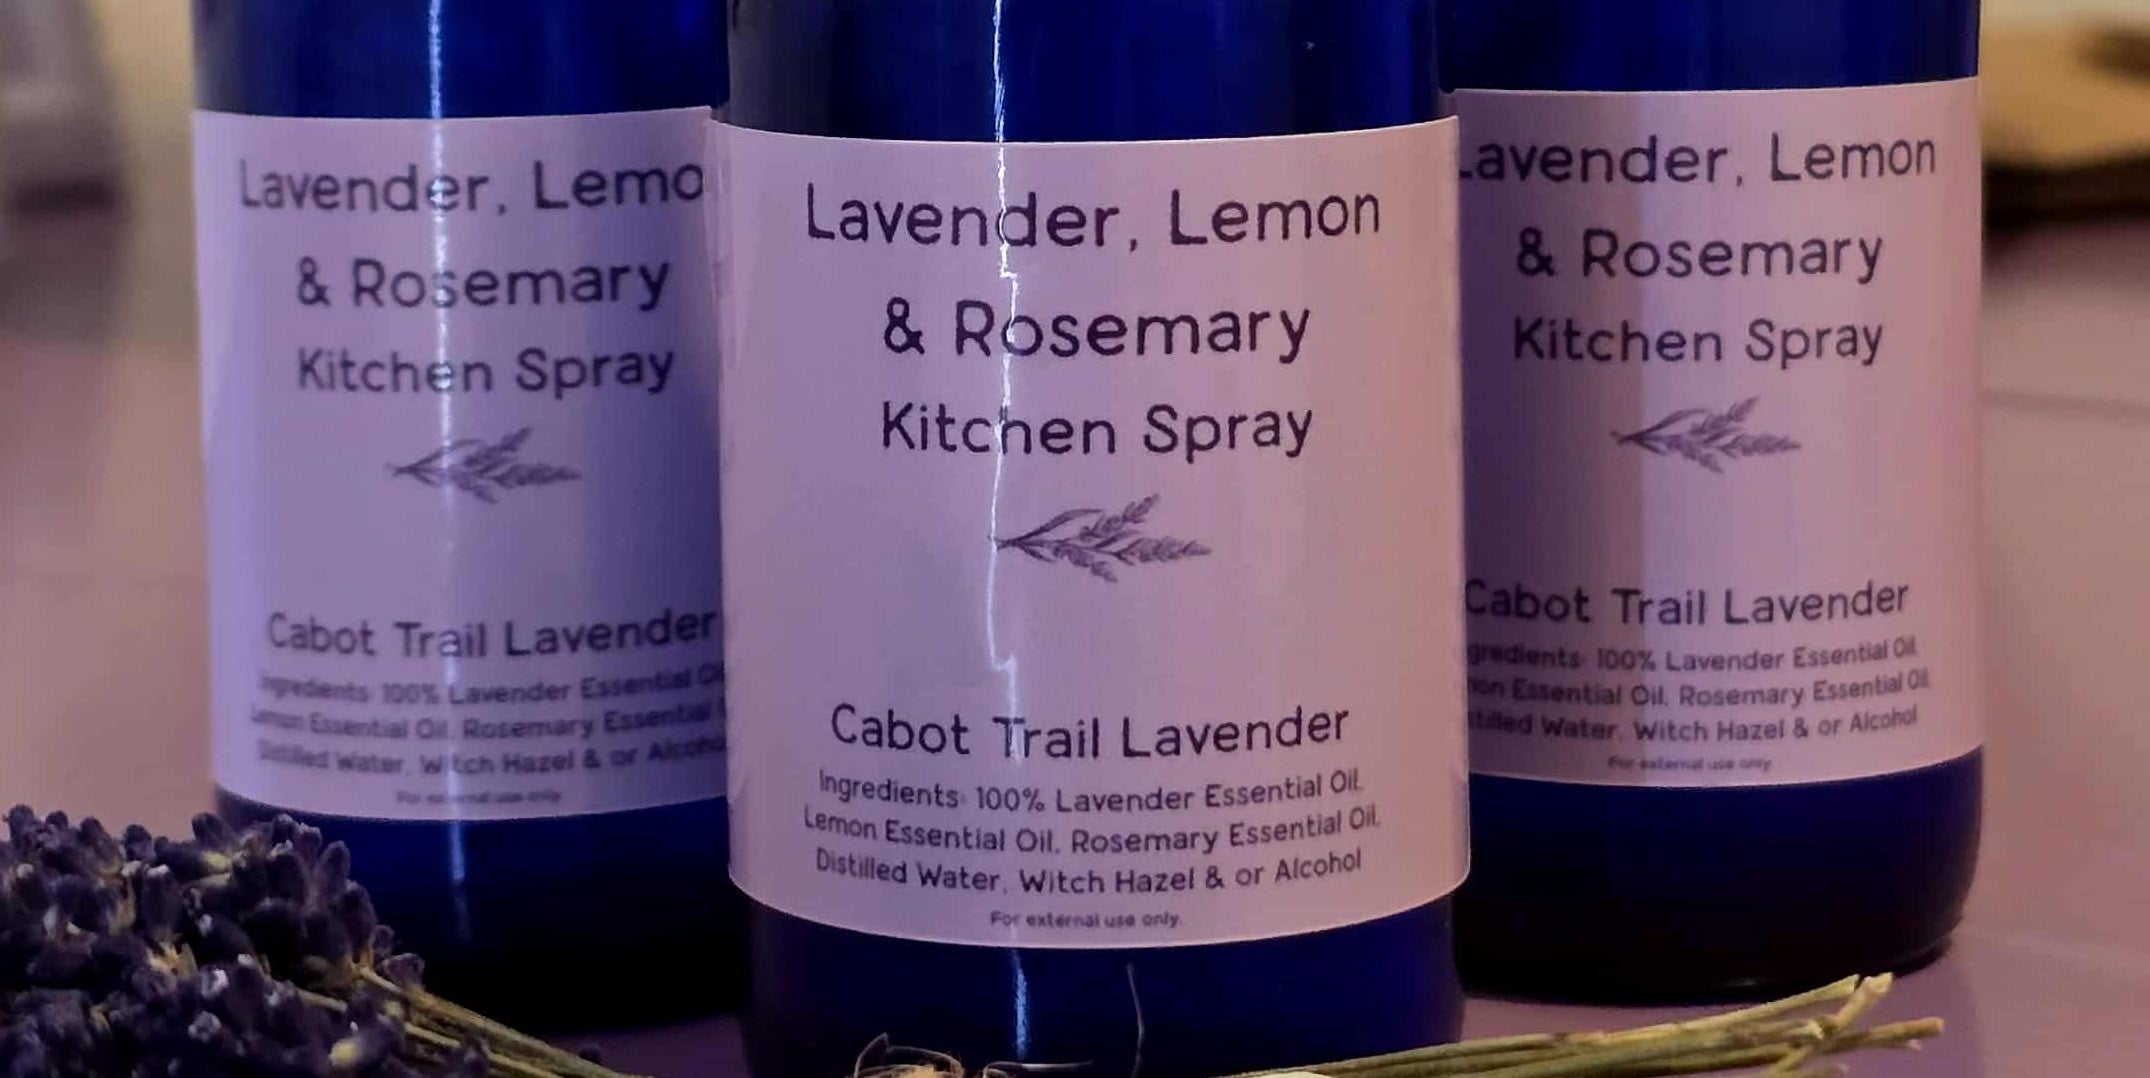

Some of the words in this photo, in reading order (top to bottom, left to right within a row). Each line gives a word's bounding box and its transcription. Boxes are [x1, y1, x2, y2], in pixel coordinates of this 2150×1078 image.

[1771, 132, 1936, 182] Lemon
[239, 159, 506, 215] Lavender,
[534, 160, 705, 211] Lemo
[806, 182, 1138, 252] Lavender,
[1169, 189, 1381, 247] Lemon
[1516, 225, 1556, 278] &
[1582, 227, 1884, 285] Rosemary
[296, 256, 330, 307] &
[352, 258, 670, 312] Rosemary
[882, 297, 925, 355] &
[954, 300, 1311, 364] Rosemary
[1513, 316, 1723, 363] Kitchen
[1745, 317, 1884, 370] Spray
[297, 347, 495, 394] Kitchen
[515, 347, 675, 400] Spray
[881, 401, 1117, 456] Kitchen
[1142, 403, 1314, 464] Spray
[1465, 577, 1591, 624] Cabot
[1610, 587, 1707, 626] Trail
[1724, 579, 1910, 626] Lavender
[268, 612, 377, 658] Cabot
[394, 620, 488, 659] Trail
[505, 608, 718, 658] Lavender
[1596, 648, 1657, 672] 100%
[1665, 649, 1785, 672] Lavender
[1792, 638, 1888, 668] Essential
[1679, 685, 1804, 709] Rosemary
[1812, 671, 1903, 701] Essential
[830, 703, 972, 756] Cabot
[992, 716, 1100, 759] Trail
[1122, 704, 1350, 759] Lavender
[1632, 718, 1708, 741] Witch
[1716, 717, 1785, 742] Hazel
[1792, 716, 1809, 739] &
[1817, 717, 1842, 737] or
[1850, 703, 1918, 733] Alcohol
[975, 786, 1046, 812] 100%
[1056, 787, 1195, 813] Lavender
[1204, 773, 1322, 808] Essential
[803, 804, 878, 840] Lemon
[885, 818, 1006, 850] Essential
[1071, 828, 1219, 855] Rosemary
[1229, 809, 1342, 847] Essential
[815, 846, 908, 884] Distilled
[1019, 868, 1105, 895] Witch
[1114, 866, 1195, 894] Hazel
[1204, 864, 1225, 890] &
[1234, 865, 1265, 887] or
[1274, 847, 1362, 883] Alcohol
[989, 909, 1020, 927] For
[1025, 910, 1099, 928] external
[1103, 913, 1136, 929] use
